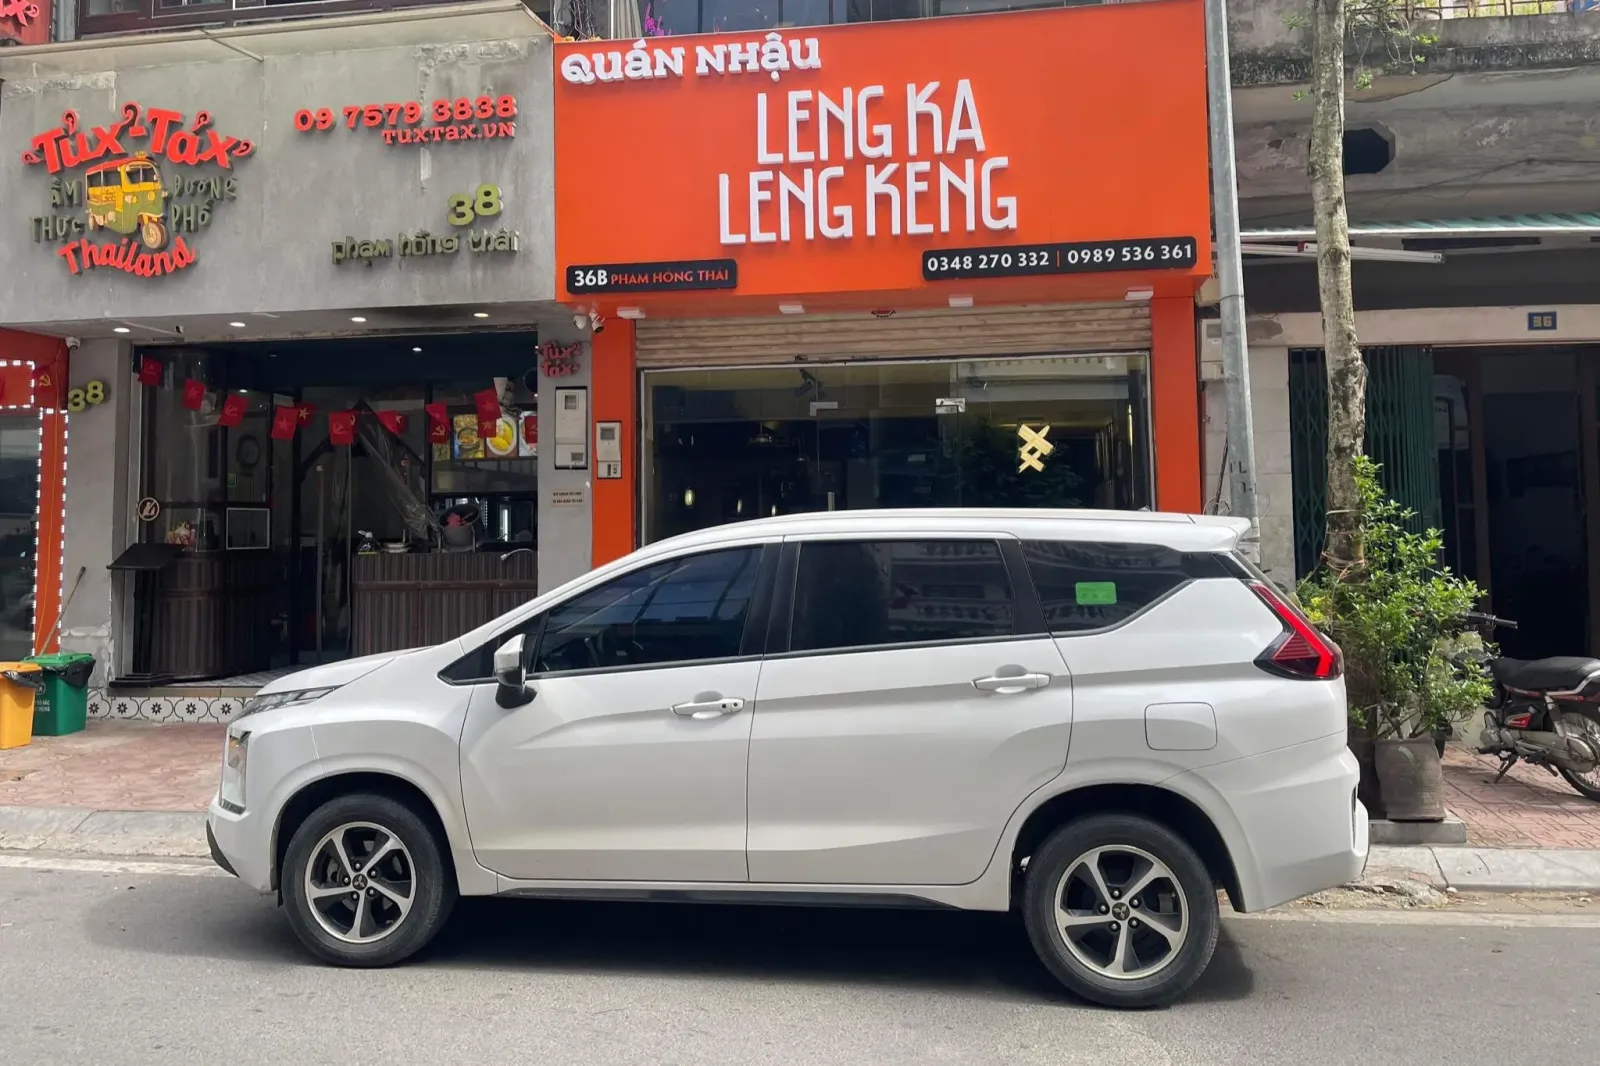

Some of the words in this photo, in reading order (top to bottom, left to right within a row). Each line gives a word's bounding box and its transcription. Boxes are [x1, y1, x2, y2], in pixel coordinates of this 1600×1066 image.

[294, 108, 335, 132] 09
[343, 102, 424, 129] 7579
[432, 94, 518, 123] 3838
[757, 84, 893, 164] LENG
[907, 79, 986, 156] KA
[447, 183, 504, 226] 38
[719, 166, 854, 245] LENG
[866, 156, 1018, 236] KENG
[57, 235, 197, 277] Thailand
[927, 256, 973, 272] 0348
[978, 253, 1012, 269] 270
[1018, 251, 1050, 267] 332
[1067, 247, 1116, 264] 0989
[1121, 245, 1155, 262] 536
[1160, 243, 1193, 260] 361
[574, 269, 608, 287] 36B
[67, 380, 105, 412] 38
